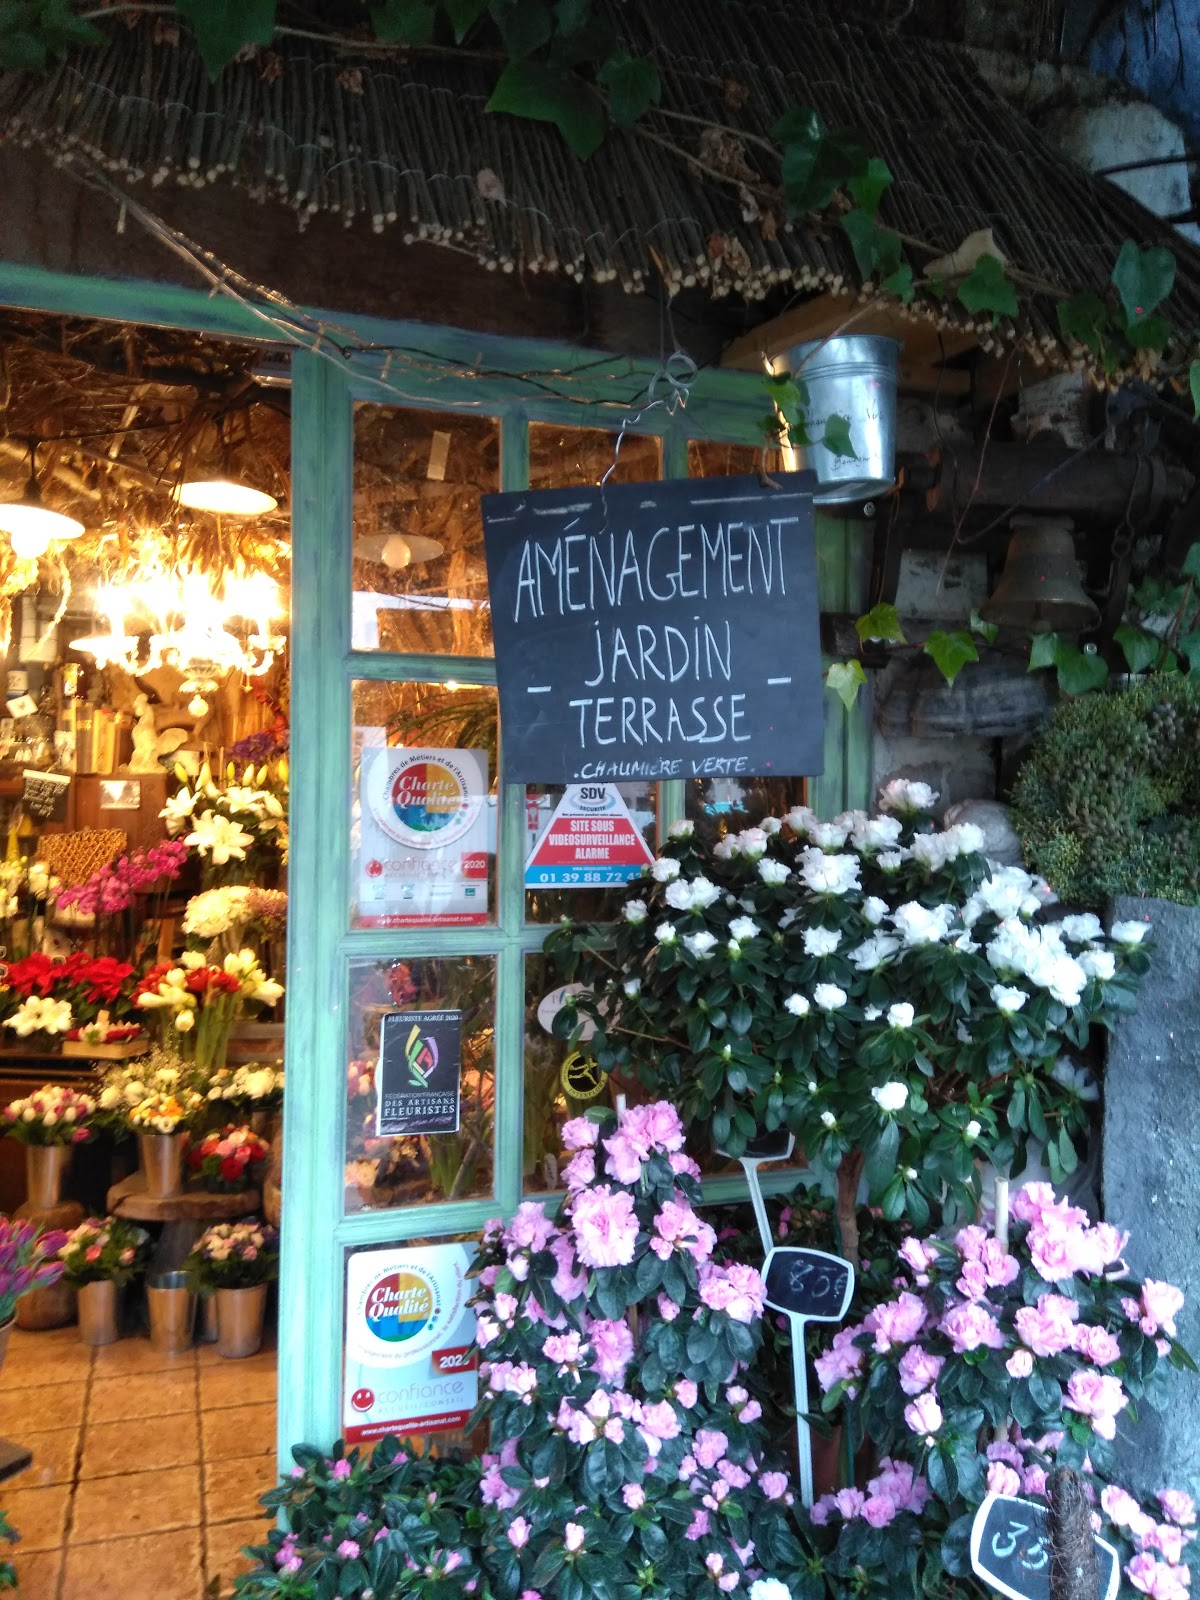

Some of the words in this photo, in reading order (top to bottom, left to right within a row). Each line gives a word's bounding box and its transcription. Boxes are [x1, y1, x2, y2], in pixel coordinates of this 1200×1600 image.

[514, 517, 799, 623] AMÉNAGEMENT
[569, 693, 751, 749] TERRASSE
[400, 760, 409, 768] de
[409, 754, 436, 763] Métiers
[445, 761, 454, 769] de
[399, 776, 454, 791] Charte
[396, 789, 457, 809] Qualité
[580, 787, 606, 799] SDV
[570, 821, 590, 832] SITE
[591, 820, 614, 831] SOUS
[549, 834, 636, 846] VIDEOSURVEILLANCE
[575, 848, 610, 859] ALARME
[463, 861, 486, 869] 2020
[540, 873, 556, 883] 01
[562, 873, 580, 883] 39
[584, 873, 601, 883] 88
[606, 872, 622, 882] 72
[407, 1097, 455, 1106] ARTISANS
[384, 1105, 455, 1117] FLEURISTES
[371, 1286, 427, 1304] Charte
[368, 1297, 429, 1323] Qualité
[378, 1381, 465, 1404] confiance
